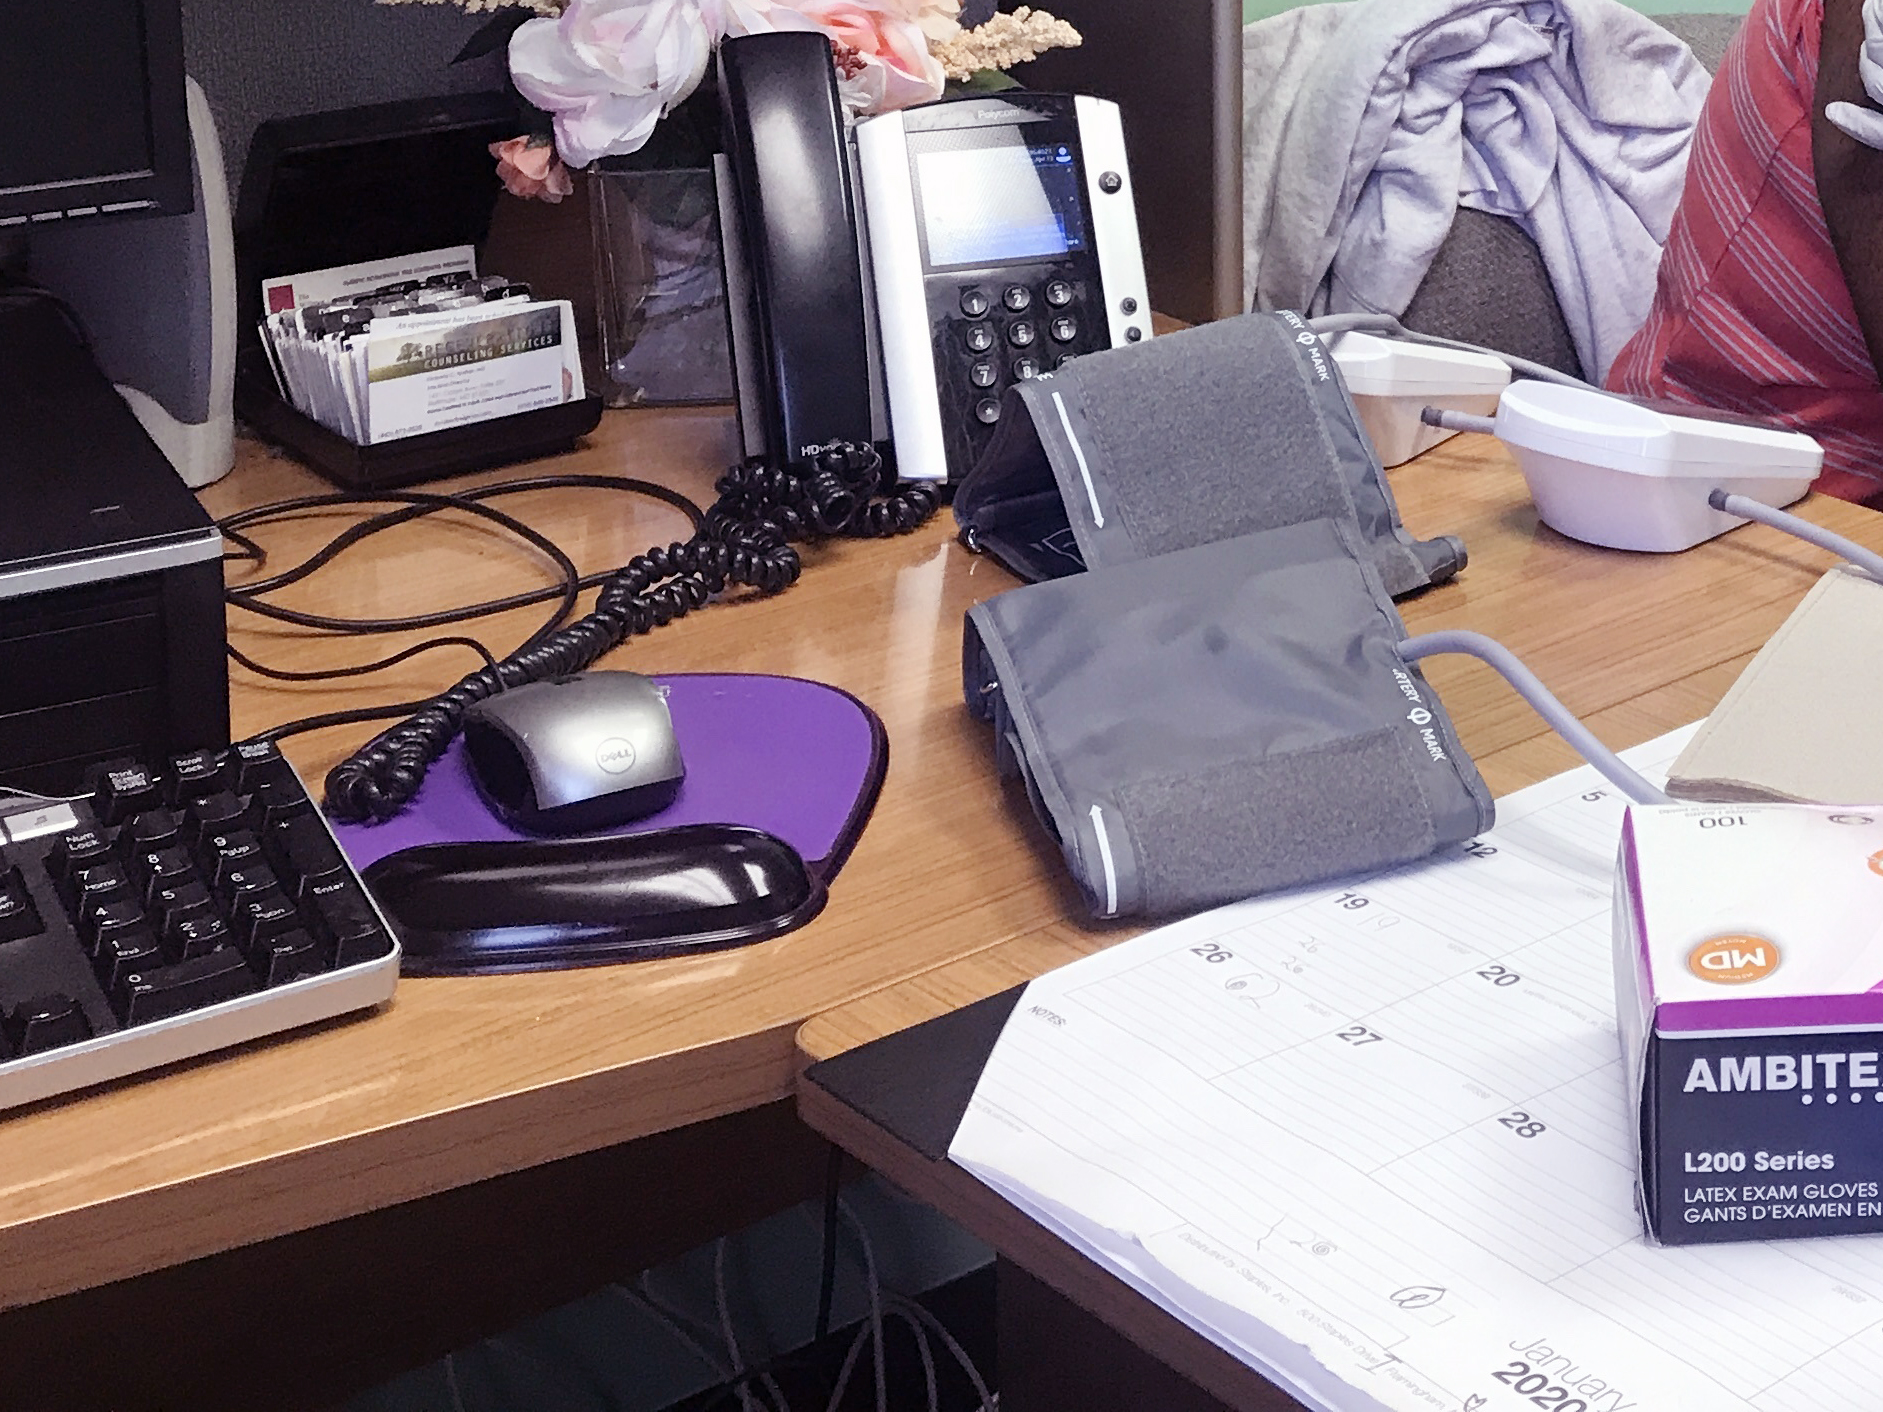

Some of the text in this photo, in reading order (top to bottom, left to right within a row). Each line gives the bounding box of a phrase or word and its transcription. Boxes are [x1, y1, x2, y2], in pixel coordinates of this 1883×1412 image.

[977, 109, 1020, 120] Polycom
[972, 290, 1064, 312] 1 2 3
[975, 326, 1069, 348] 4 5 6
[424, 334, 553, 368] COUNSELING SERVICES
[1308, 348, 1330, 381] MARK
[979, 371, 988, 384] 7
[1022, 366, 1032, 379] 8
[1420, 728, 1446, 762] MARK
[601, 748, 631, 763] DELL
[108, 769, 132, 779] Print
[179, 764, 203, 774] Lock
[1582, 790, 1608, 802] 5
[1698, 815, 1748, 829] 100
[66, 832, 94, 842] Num
[214, 837, 227, 846] 9
[69, 840, 100, 851] Lock
[220, 845, 250, 857] PgUp
[1464, 841, 1498, 859] 12
[148, 854, 160, 864] 8
[78, 870, 90, 880] 7
[230, 872, 244, 882] 6
[162, 890, 176, 900] 5
[313, 882, 345, 896] Enter
[250, 903, 262, 912] 3
[1334, 892, 1370, 911] 19
[180, 922, 194, 931] 2
[1190, 942, 1233, 964] 26
[1700, 948, 1766, 970] MD
[128, 974, 142, 984] 0
[1476, 964, 1520, 988] 20
[1336, 1026, 1384, 1047] 27
[1496, 1111, 1546, 1139] 28
[1684, 1150, 1835, 1173] L200 Series
[1684, 1182, 1879, 1203] LATEX EXAM GLOVES
[1684, 1206, 1748, 1224] GANTS
[1752, 1202, 1851, 1221] D'EXAMEN
[1857, 1202, 1882, 1217] EN
[1508, 1338, 1638, 1412] January
[1491, 1360, 1588, 1412] 2020
